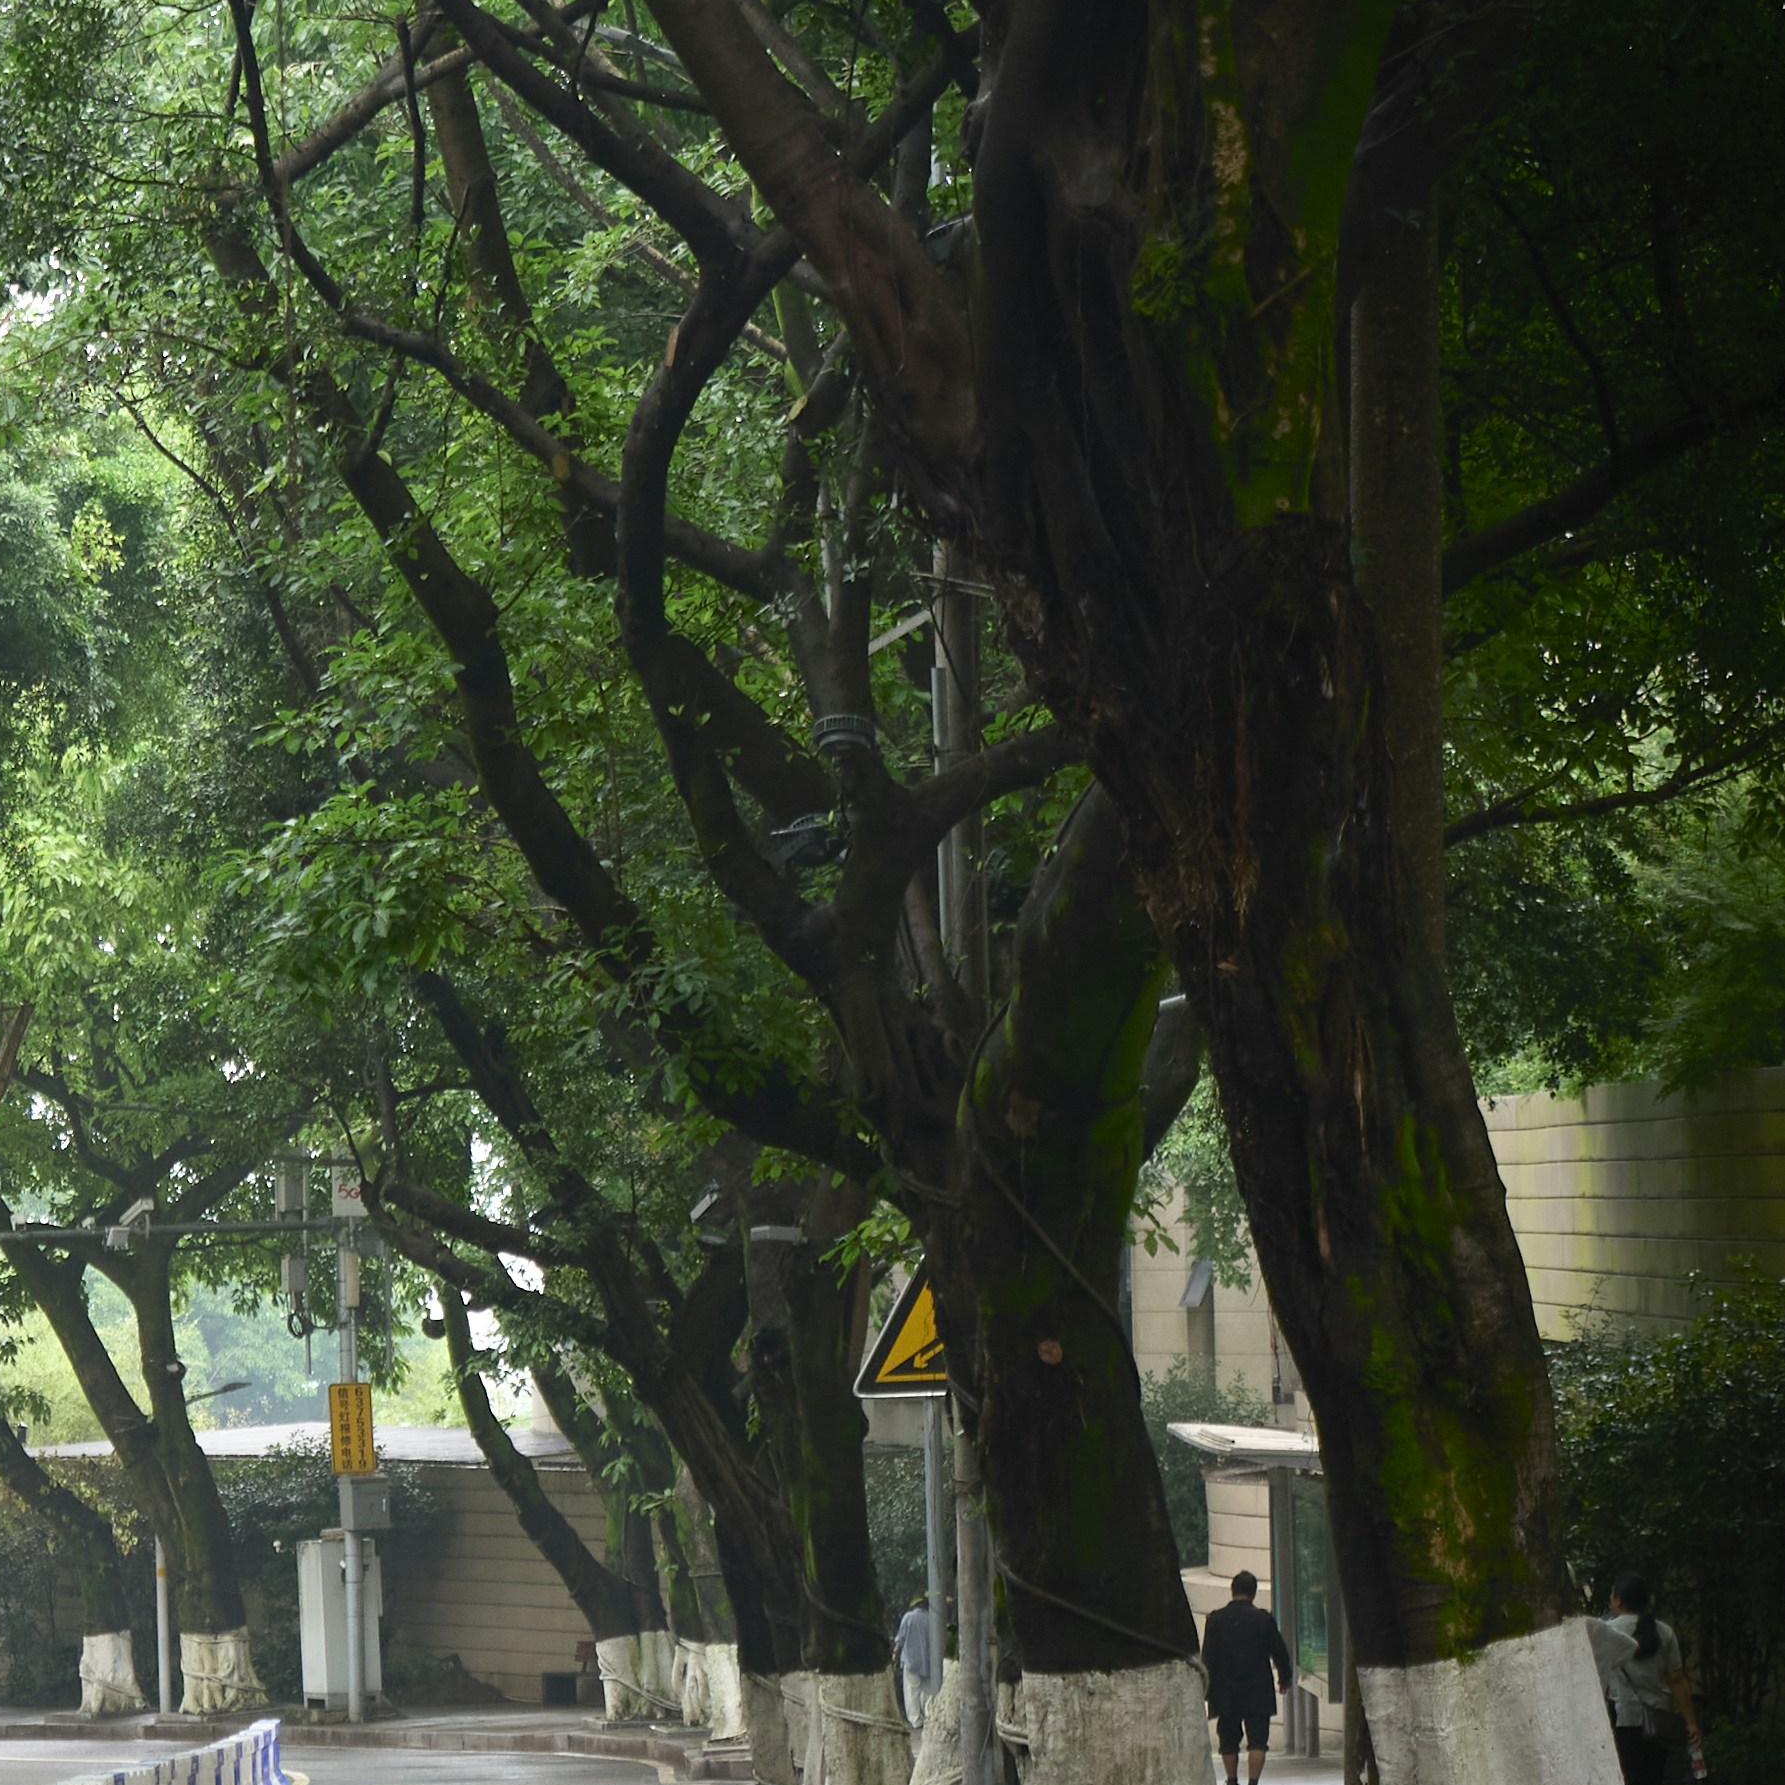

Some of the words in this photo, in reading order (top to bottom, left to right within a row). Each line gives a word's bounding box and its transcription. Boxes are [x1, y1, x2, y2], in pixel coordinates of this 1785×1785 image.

[338, 1183, 361, 1200] 5G
[338, 1388, 353, 1471] 信号灯报修电话
